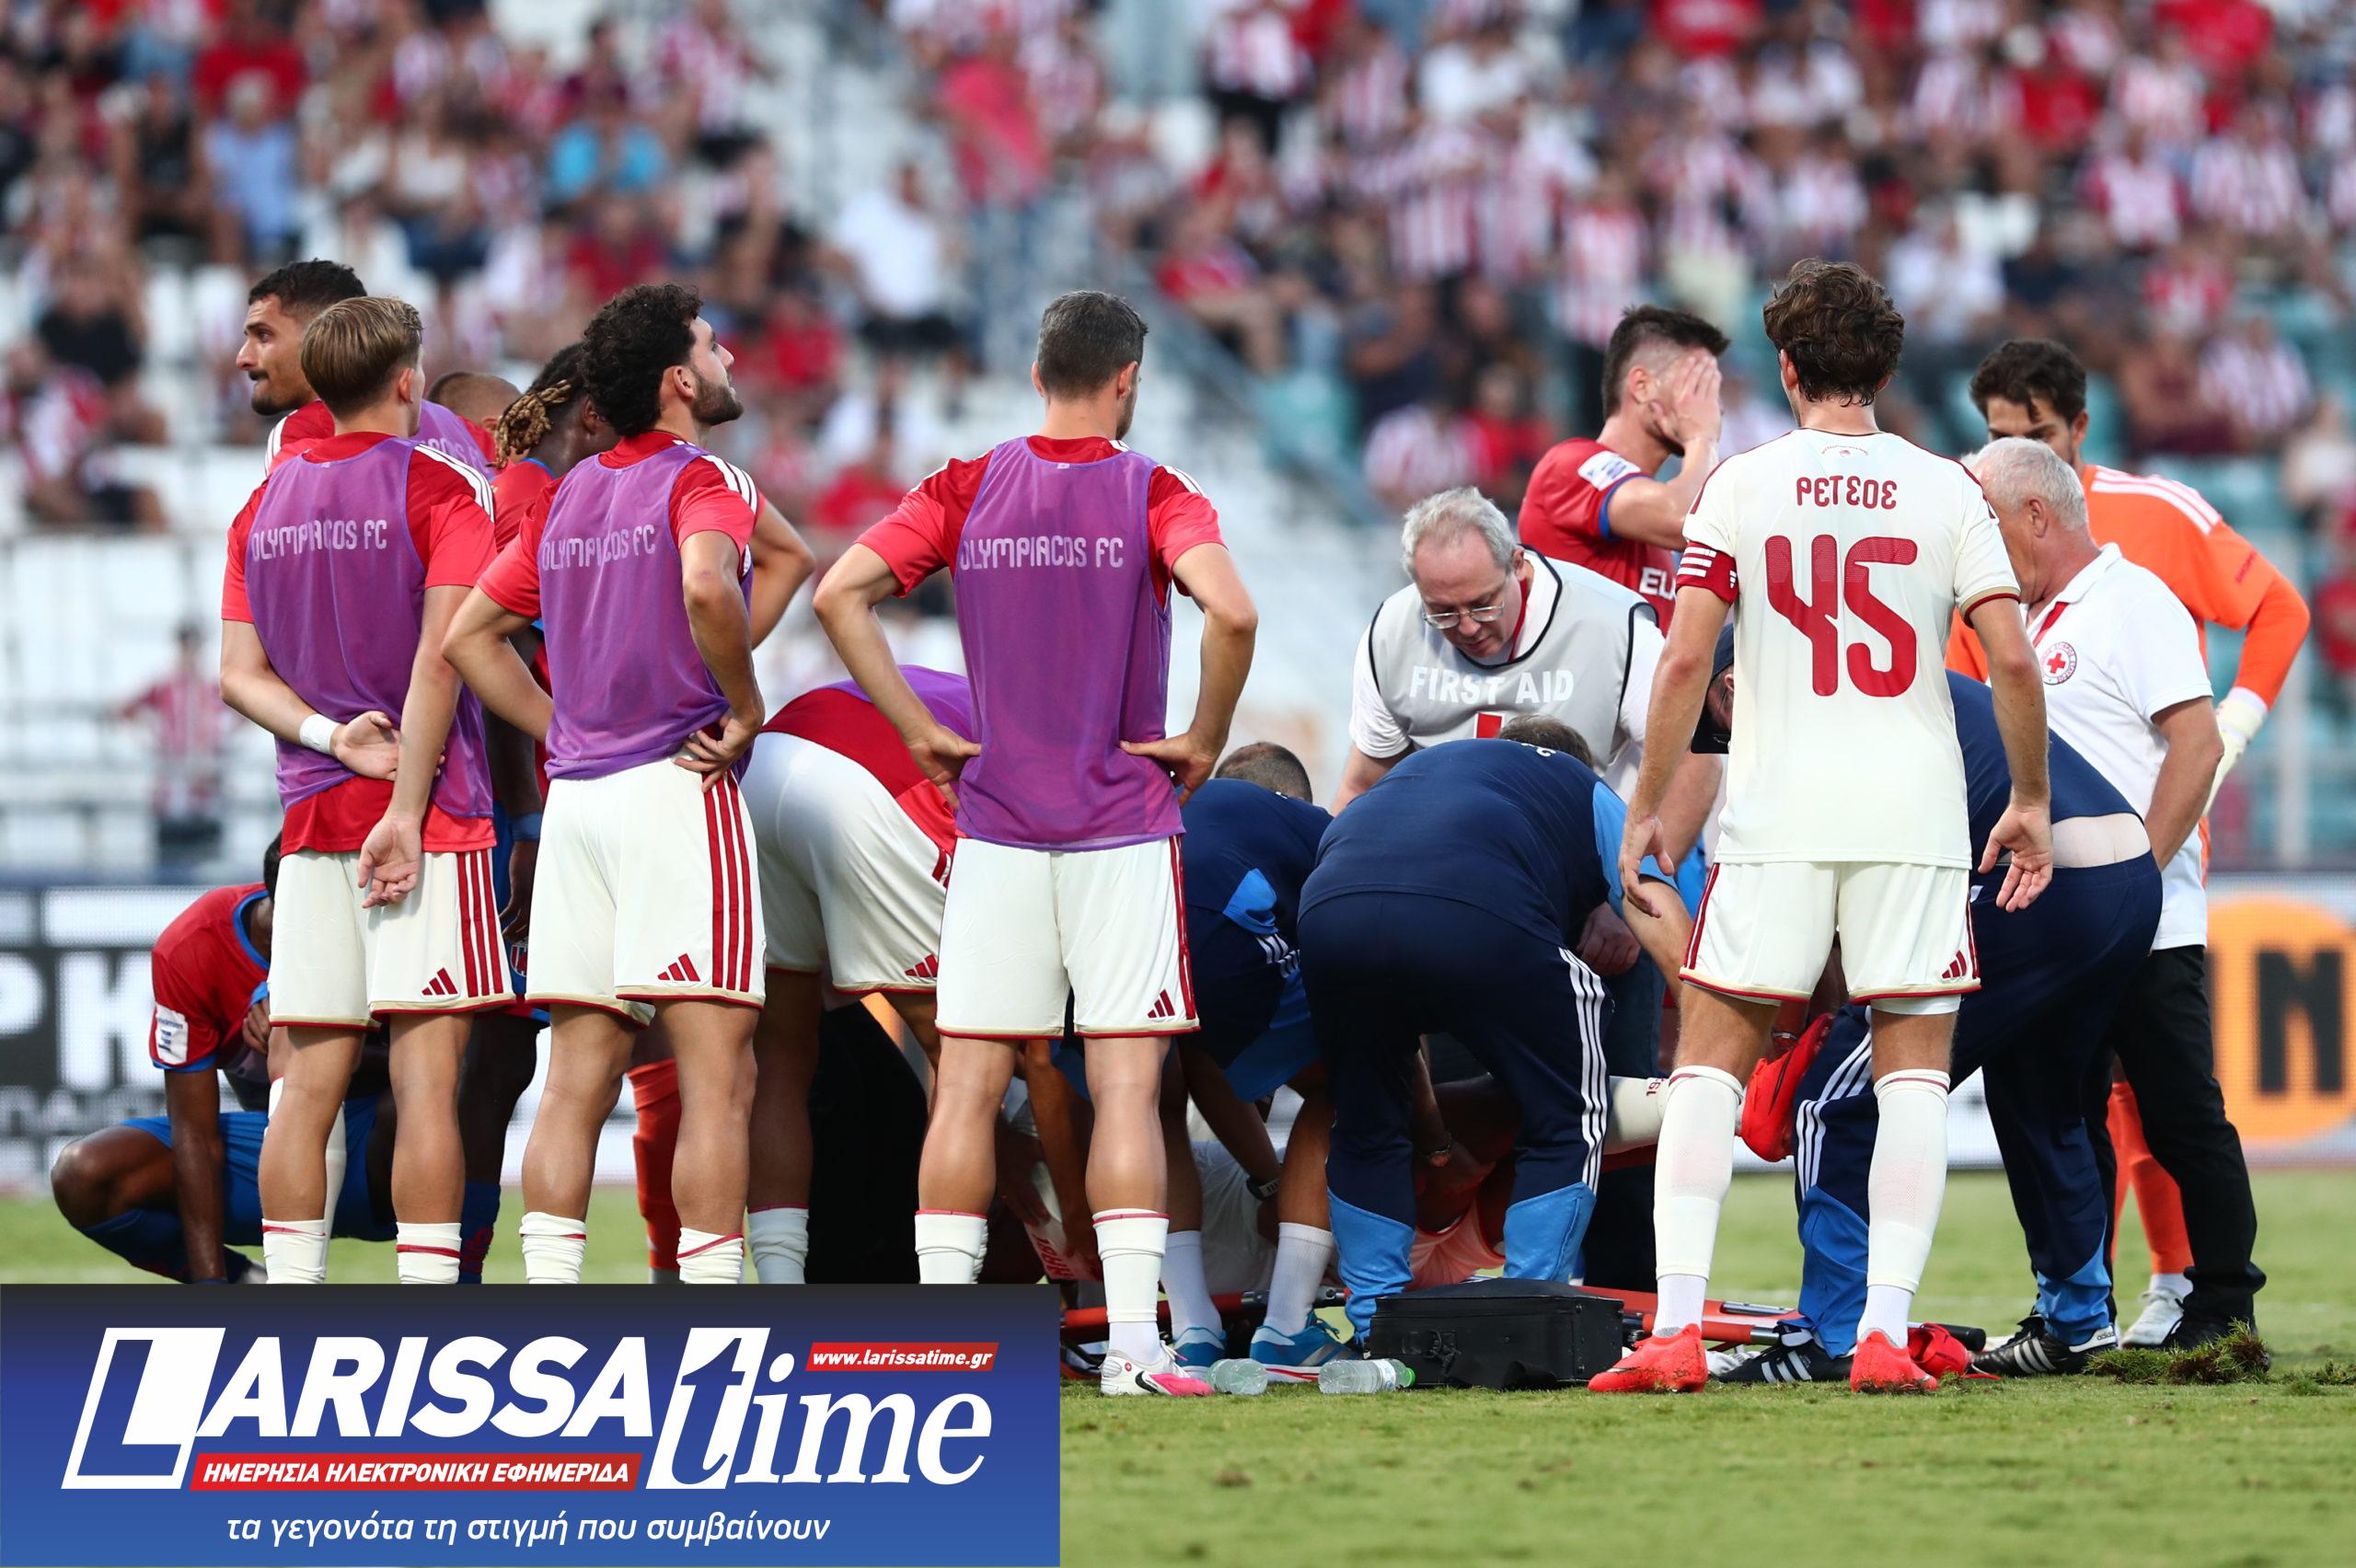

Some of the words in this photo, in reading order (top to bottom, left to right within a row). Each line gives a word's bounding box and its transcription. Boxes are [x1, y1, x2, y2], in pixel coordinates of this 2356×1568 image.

[364, 519, 387, 550] FC
[632, 524, 656, 556] FC
[959, 535, 1088, 571] OLYMPIACOS
[1095, 536, 1124, 568] FC
[1764, 534, 1918, 698] 45
[1409, 665, 1506, 705] FIRST
[1515, 669, 1575, 705] AID
